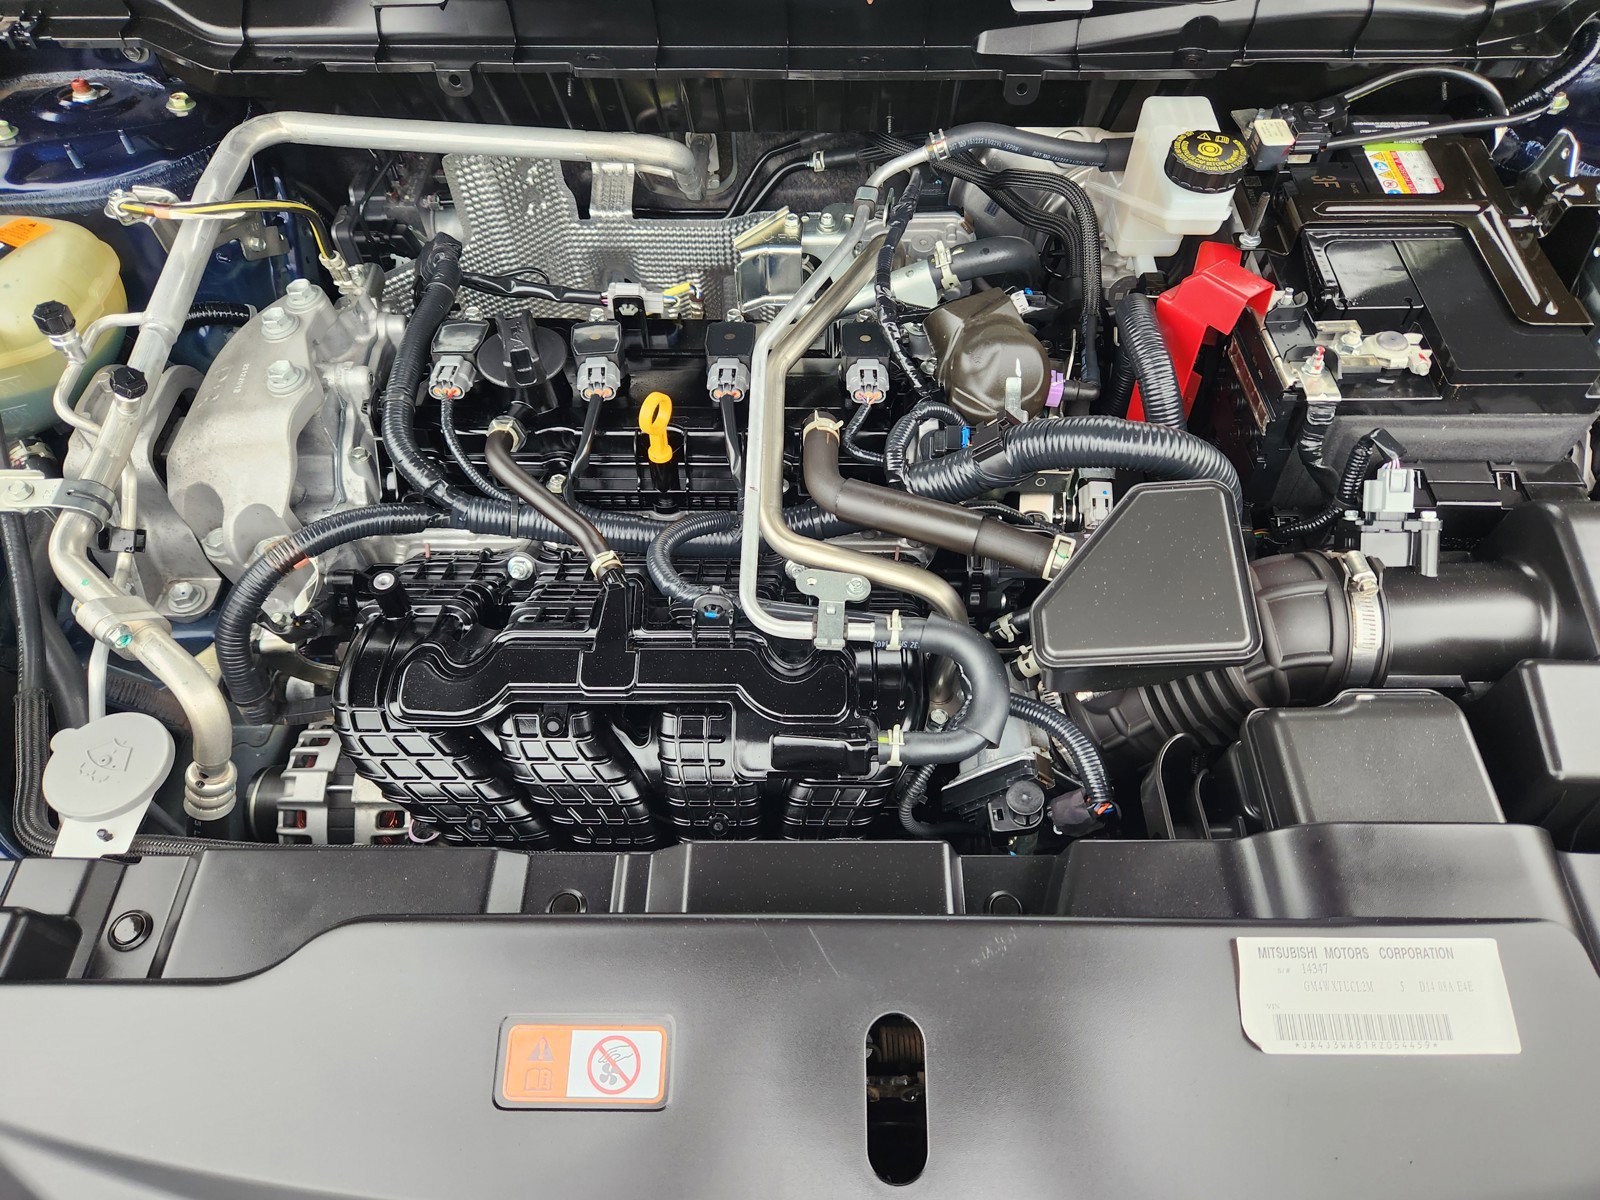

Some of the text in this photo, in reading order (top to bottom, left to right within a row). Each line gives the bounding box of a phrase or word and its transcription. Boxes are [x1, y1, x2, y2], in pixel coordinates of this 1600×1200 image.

[1258, 946, 1455, 960] MITSUBISHI MOTORS CORPORATION
[1301, 962, 1329, 975] 14347
